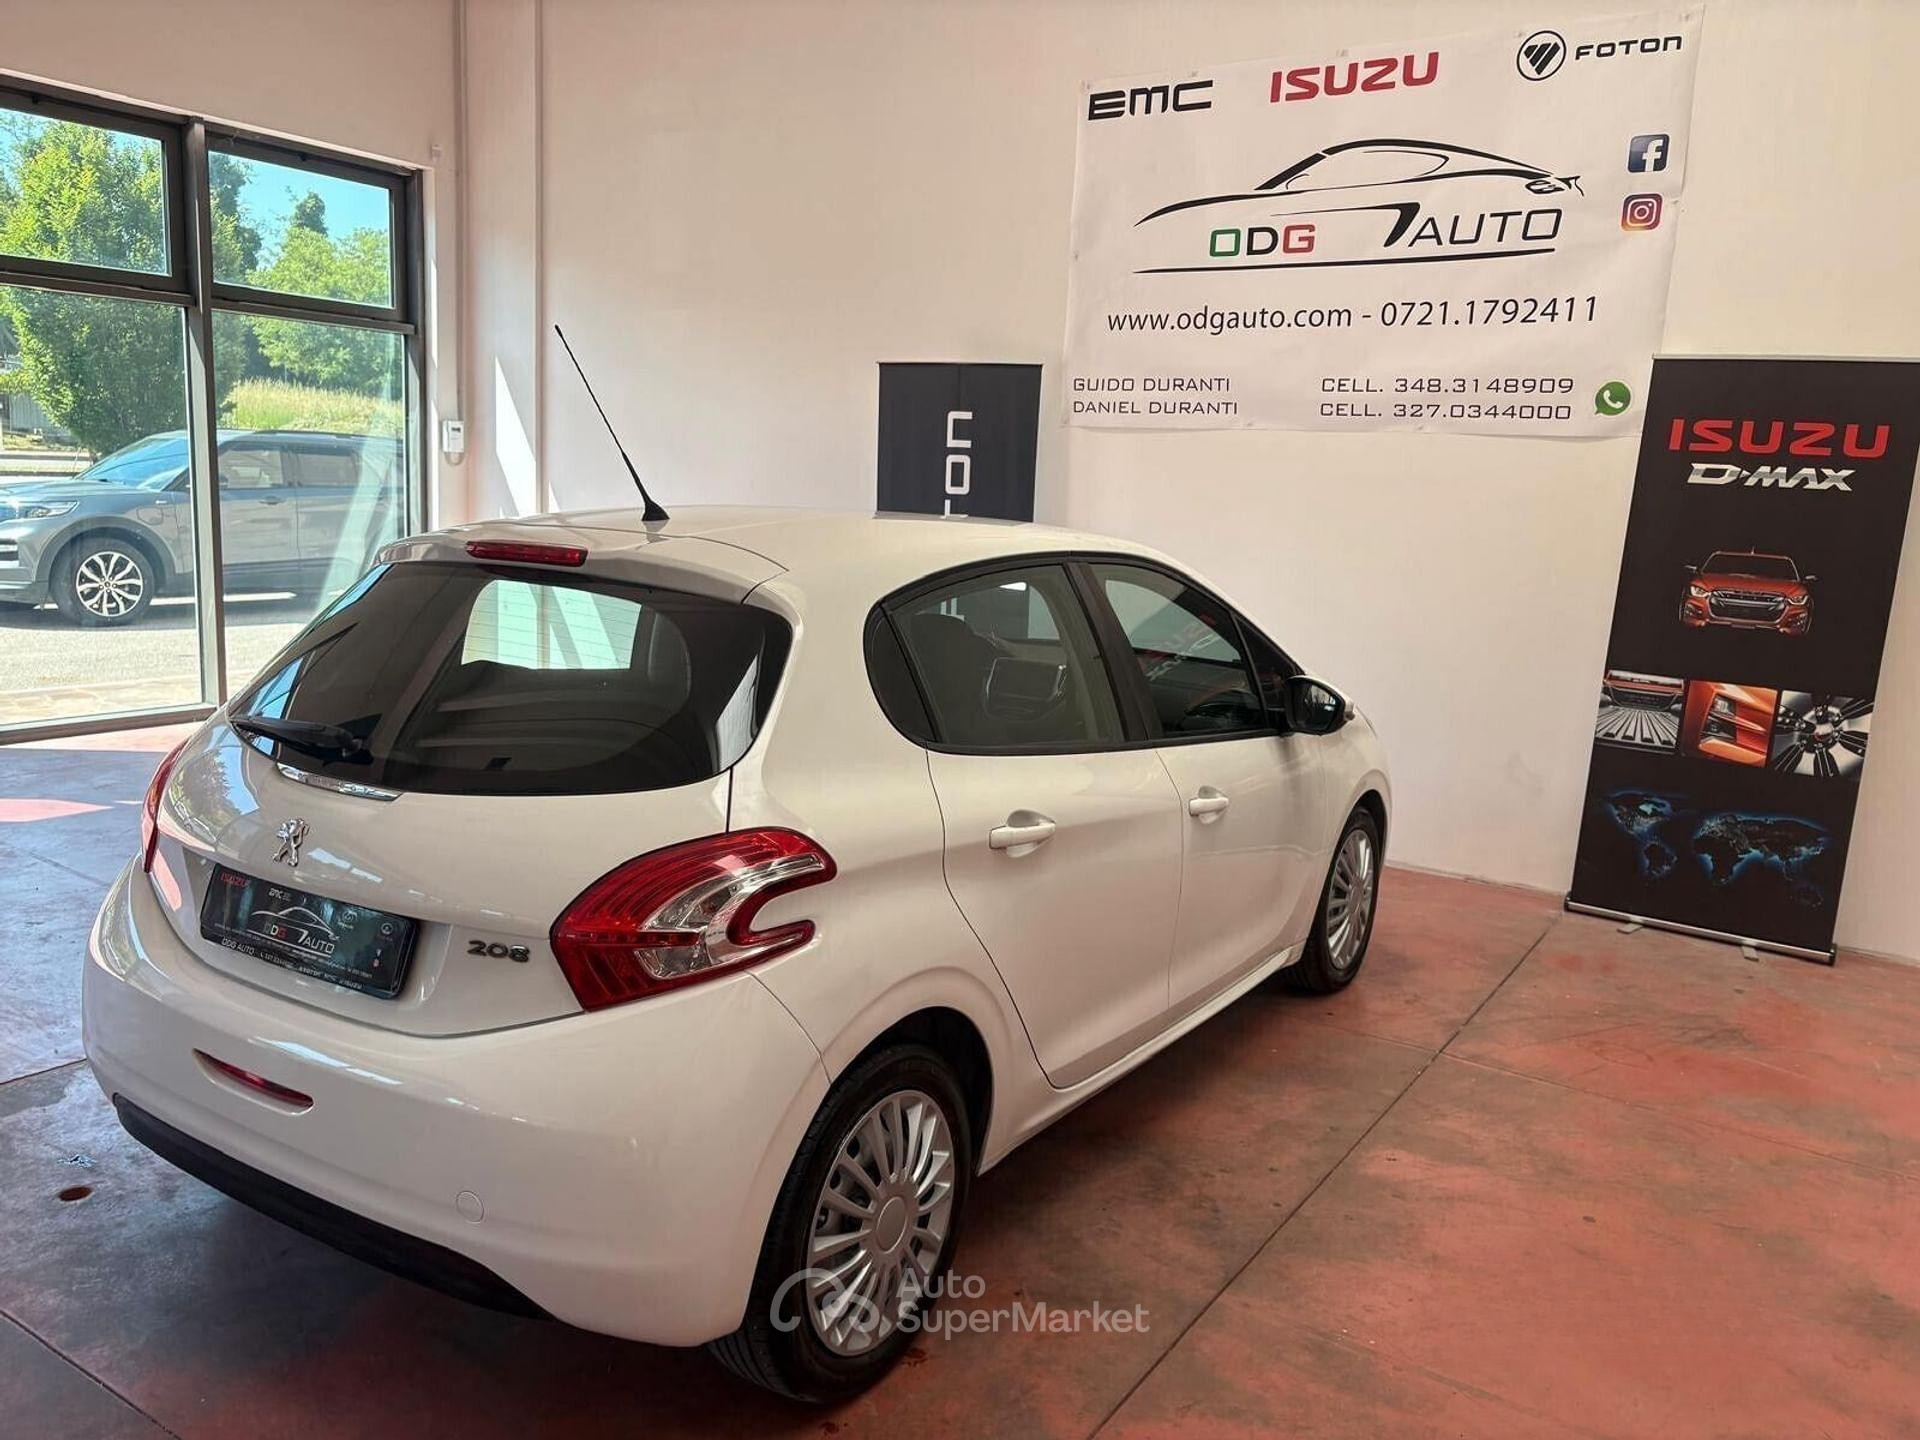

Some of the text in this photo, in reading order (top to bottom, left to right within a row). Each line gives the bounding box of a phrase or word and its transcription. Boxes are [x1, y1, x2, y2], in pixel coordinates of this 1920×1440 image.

[1575, 35, 1683, 60] FOTON
[1270, 52, 1439, 103] ISUZU
[1088, 80, 1214, 121] EMC
[1209, 224, 1316, 257] ODG
[1107, 305, 1352, 336] www.odgauto.com
[1381, 296, 1598, 328] 0721.1792411
[1073, 378, 1230, 392] GUIDO DURANTI
[1321, 378, 1574, 394] CELL. 348.3148909
[1073, 401, 1238, 415] DANIEL DURANTI
[1320, 403, 1572, 420] CELL. 327.0344000
[1668, 418, 1891, 459] ISUZU
[1687, 463, 1856, 491] D-MAX
[467, 940, 530, 963] 208
